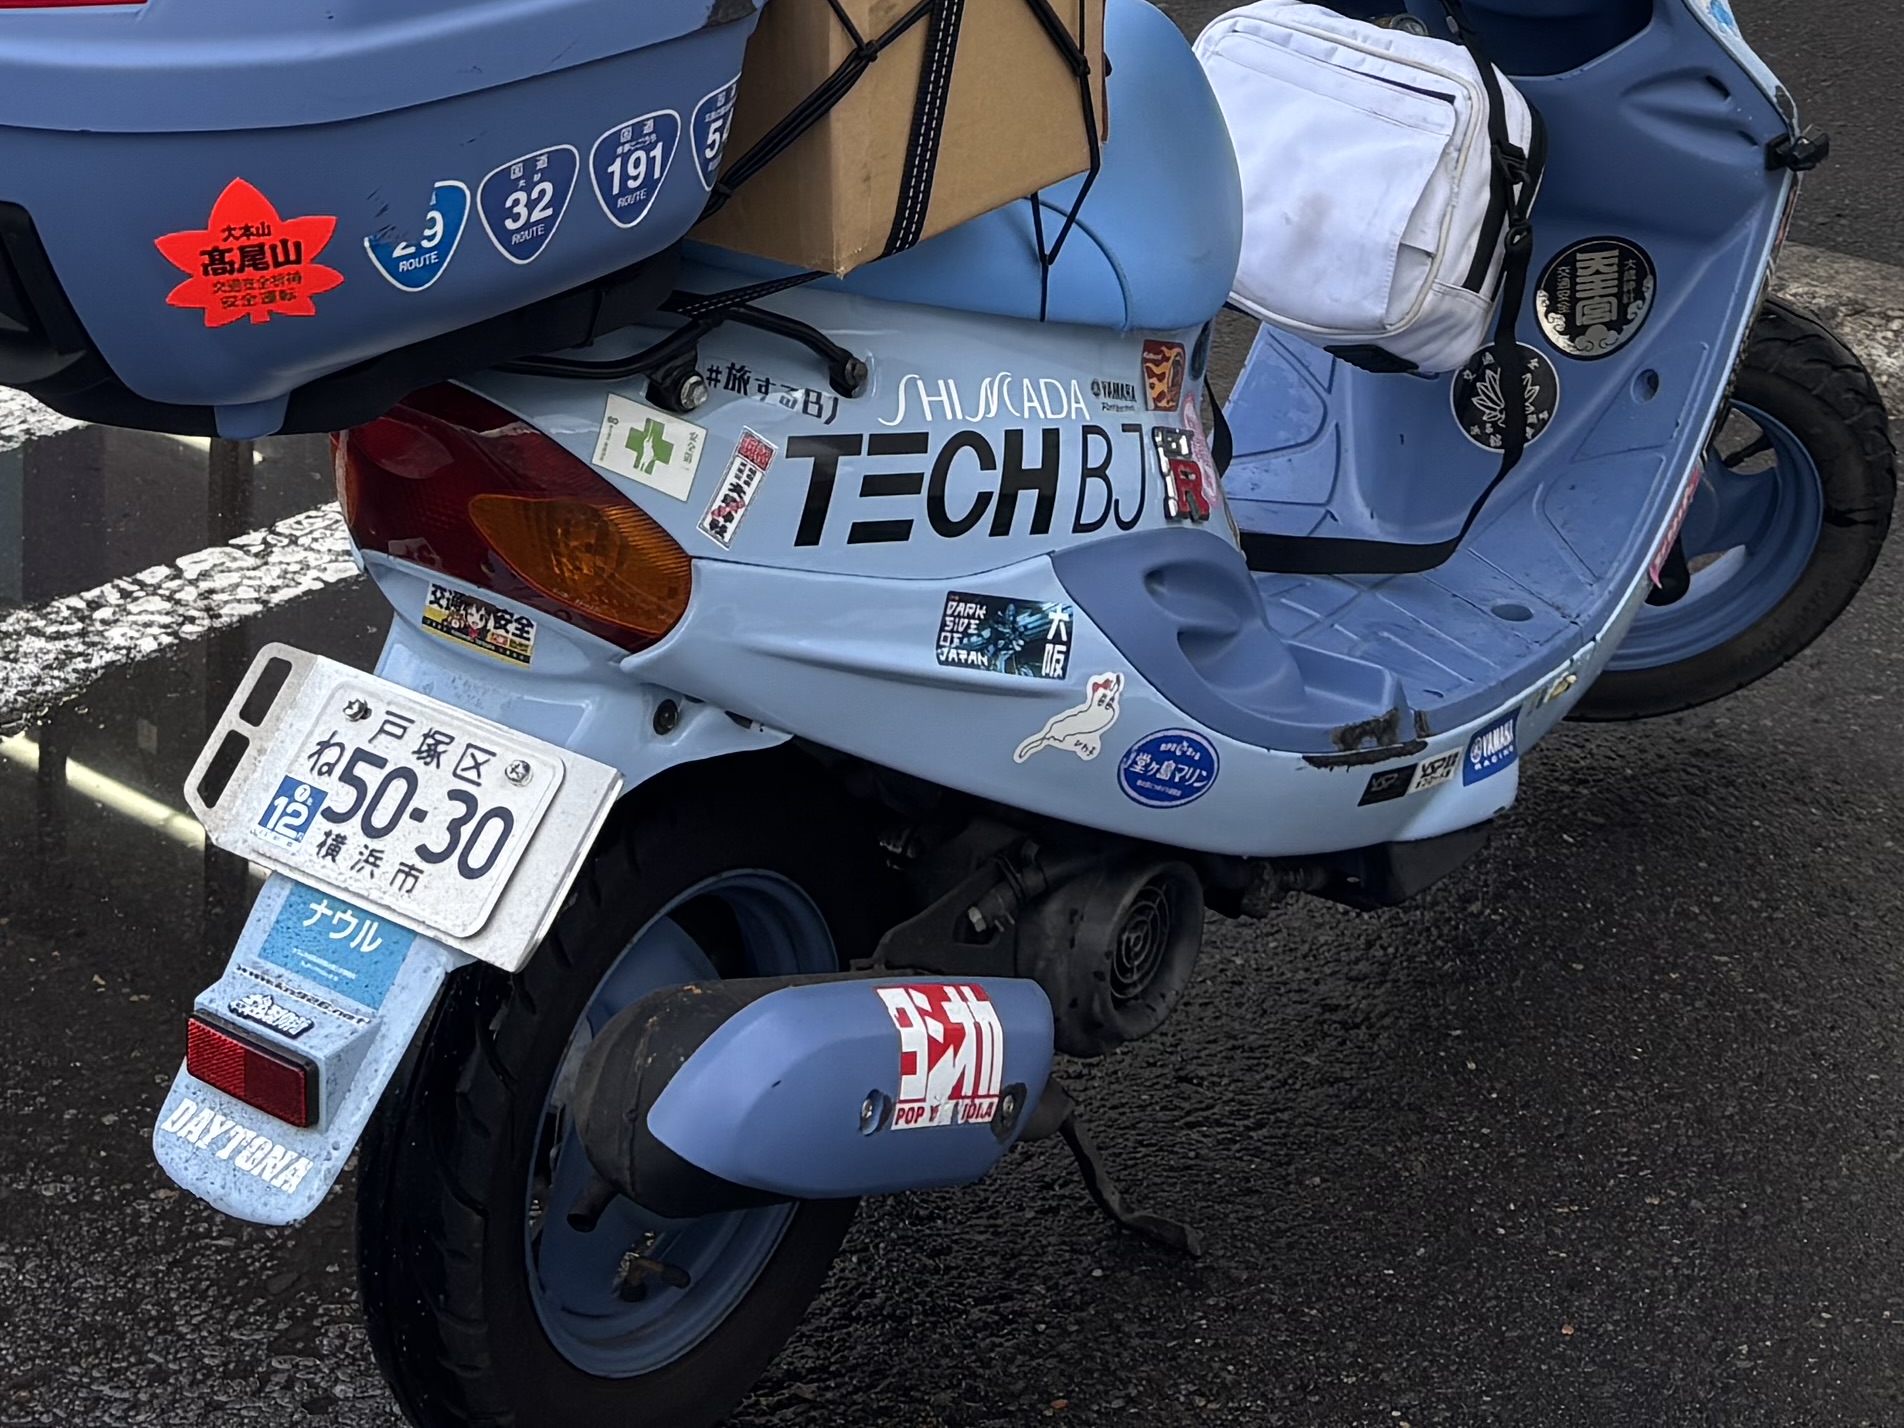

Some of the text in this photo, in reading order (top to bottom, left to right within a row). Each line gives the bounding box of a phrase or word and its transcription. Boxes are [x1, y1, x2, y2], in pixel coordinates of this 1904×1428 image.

[607, 140, 665, 197] 191
[503, 180, 554, 232] 32
[616, 187, 648, 210] ROUTE
[220, 219, 272, 243] 大本山
[511, 224, 546, 247] ROUTE
[399, 250, 440, 274] ROUTE
[785, 424, 1060, 548] TECH
[1072, 422, 1146, 534] BJ
[494, 608, 535, 642] 安全
[944, 615, 980, 634] SIDE
[946, 600, 987, 620] DARK
[937, 648, 989, 667] JAPAN
[1041, 604, 1071, 678] 大阪
[368, 709, 497, 787] 戸塚区
[1474, 745, 1515, 771] RACING
[1129, 752, 1209, 787] 堂ヶ島マリン
[266, 796, 309, 841] 12
[307, 730, 515, 880] ね 50-30
[314, 828, 427, 895] 横浜市
[303, 899, 384, 953] ナウル
[894, 1105, 925, 1126] POP
[161, 1098, 314, 1196] DAYTONA
